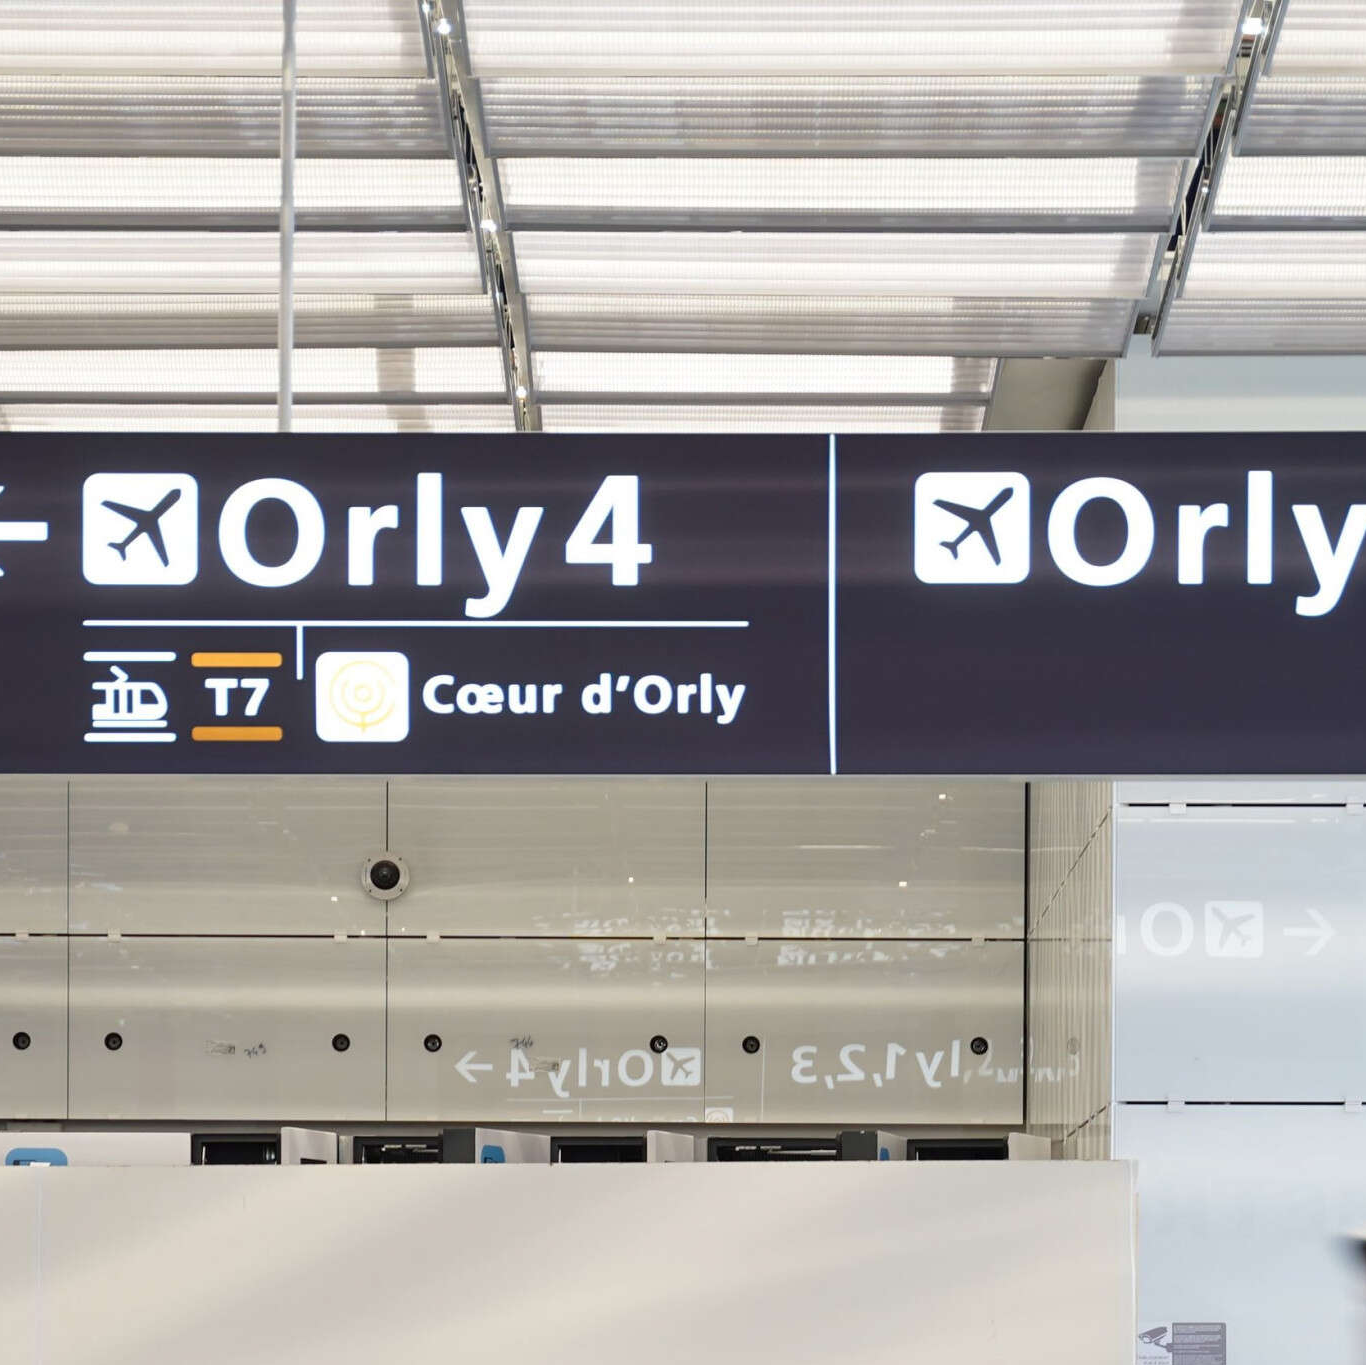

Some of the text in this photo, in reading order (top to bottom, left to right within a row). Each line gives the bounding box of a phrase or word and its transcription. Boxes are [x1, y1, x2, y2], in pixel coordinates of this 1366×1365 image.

[219, 472, 652, 618] Orly 4
[204, 678, 270, 717] T7
[422, 672, 746, 725] Cœur d’Orly
